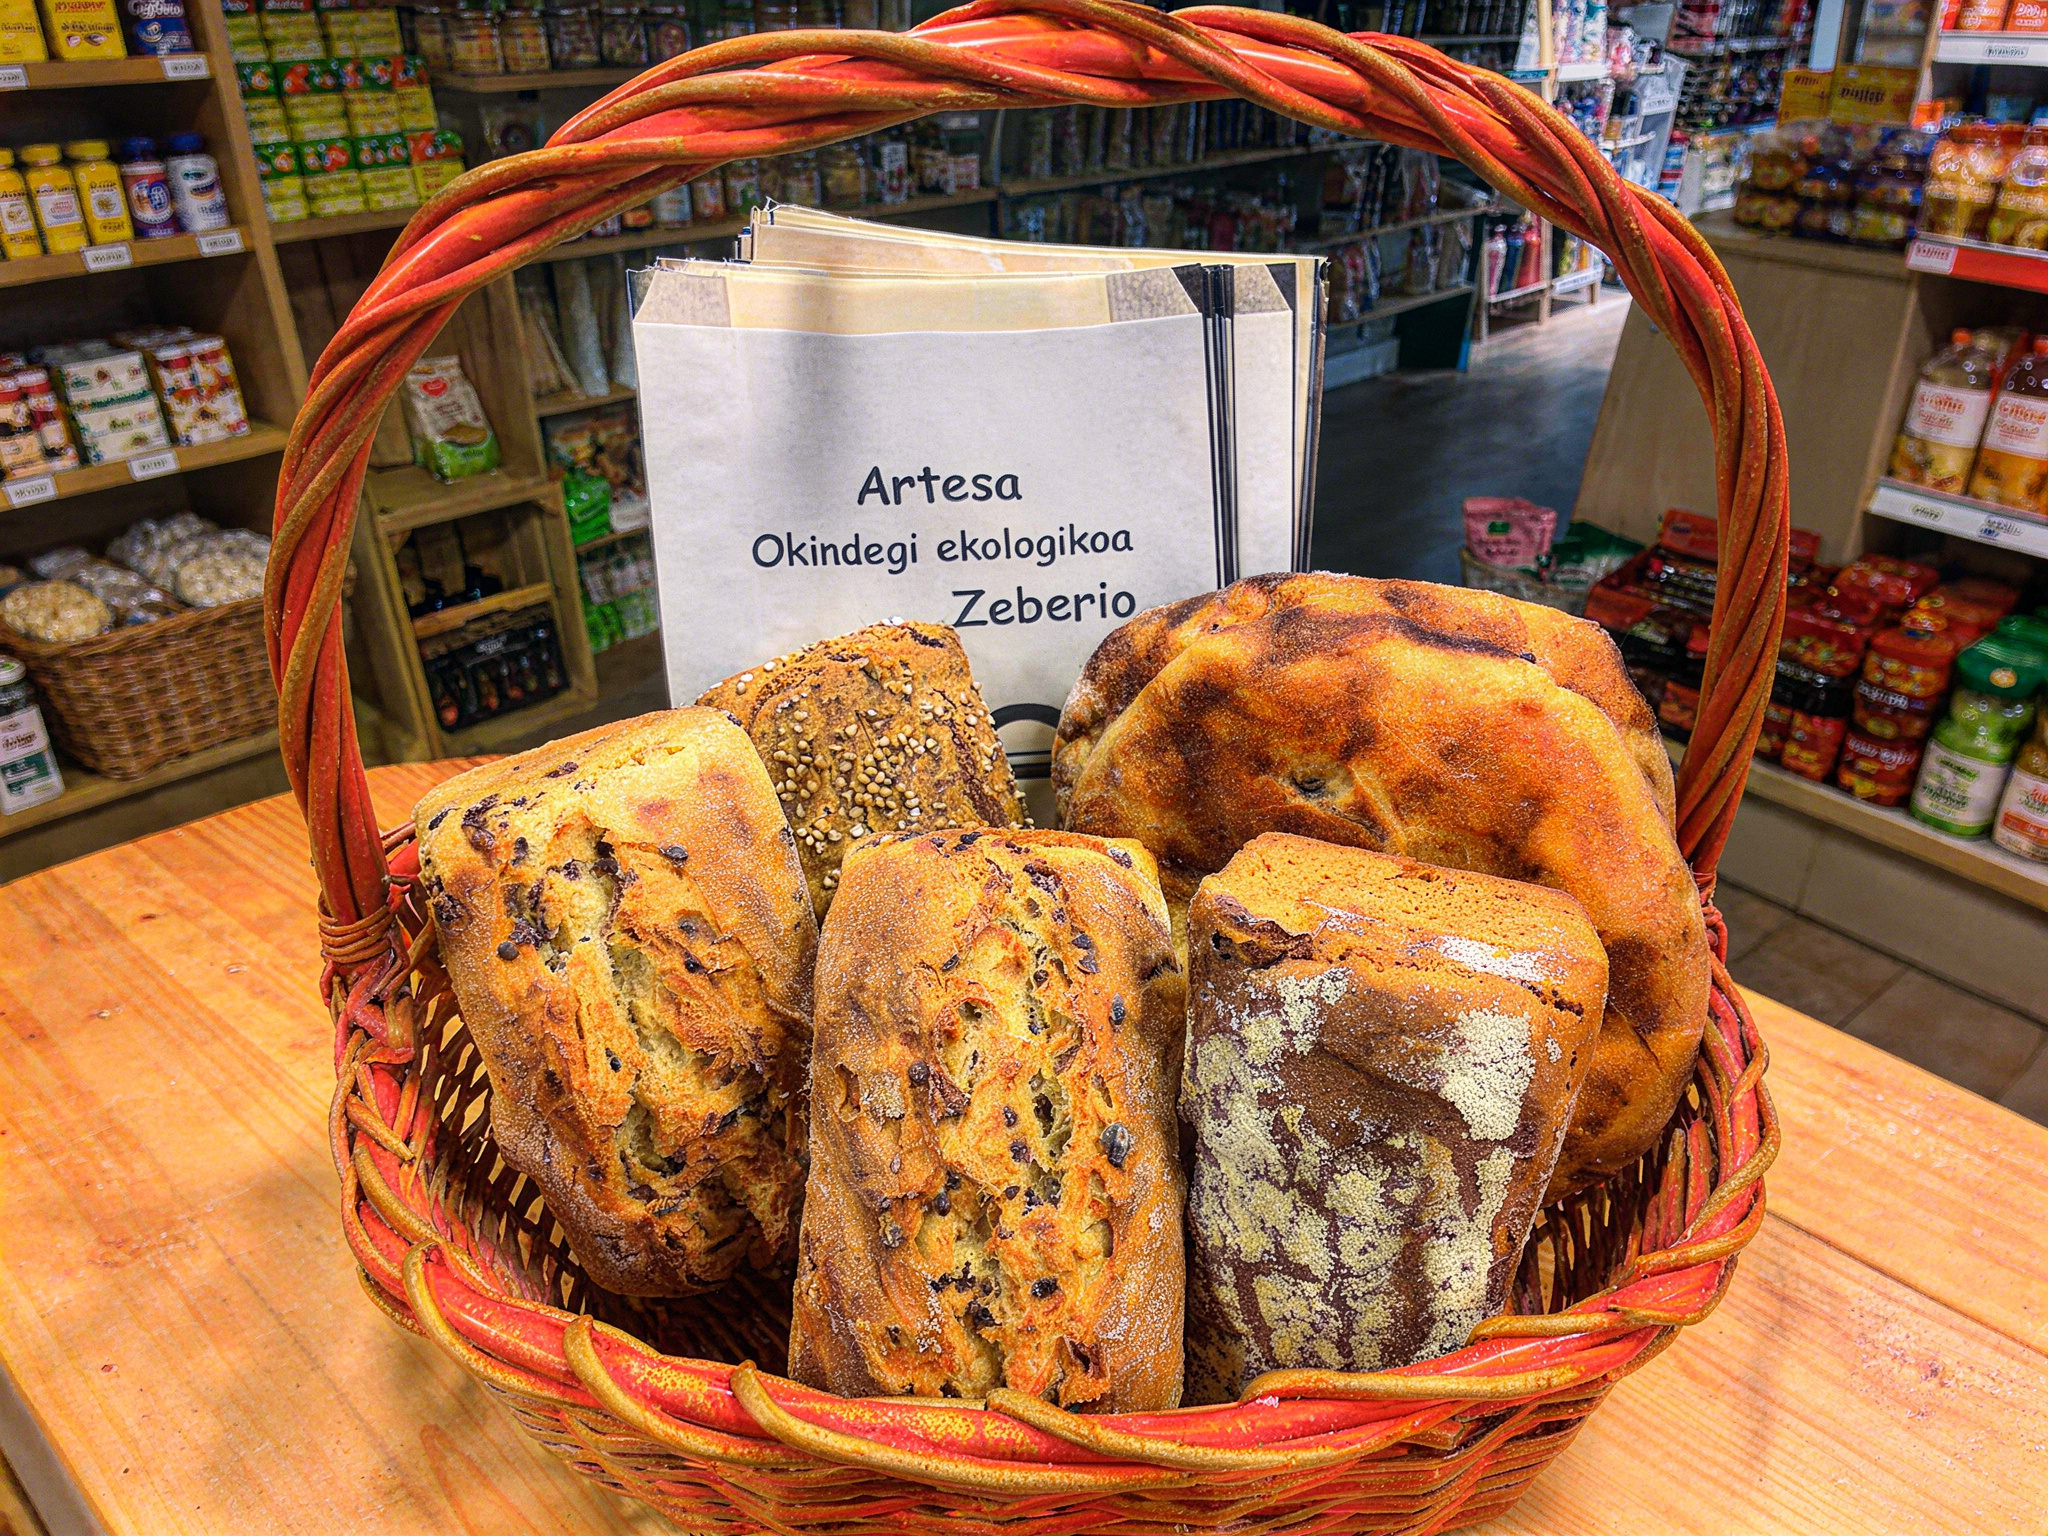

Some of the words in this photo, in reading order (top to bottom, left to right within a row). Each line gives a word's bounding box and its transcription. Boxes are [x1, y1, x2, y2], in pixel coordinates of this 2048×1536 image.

[857, 464, 1023, 507] Artesa
[752, 529, 918, 576] Okindegi
[936, 522, 1134, 568] ekologikoa
[951, 581, 1137, 629] Zeberio
